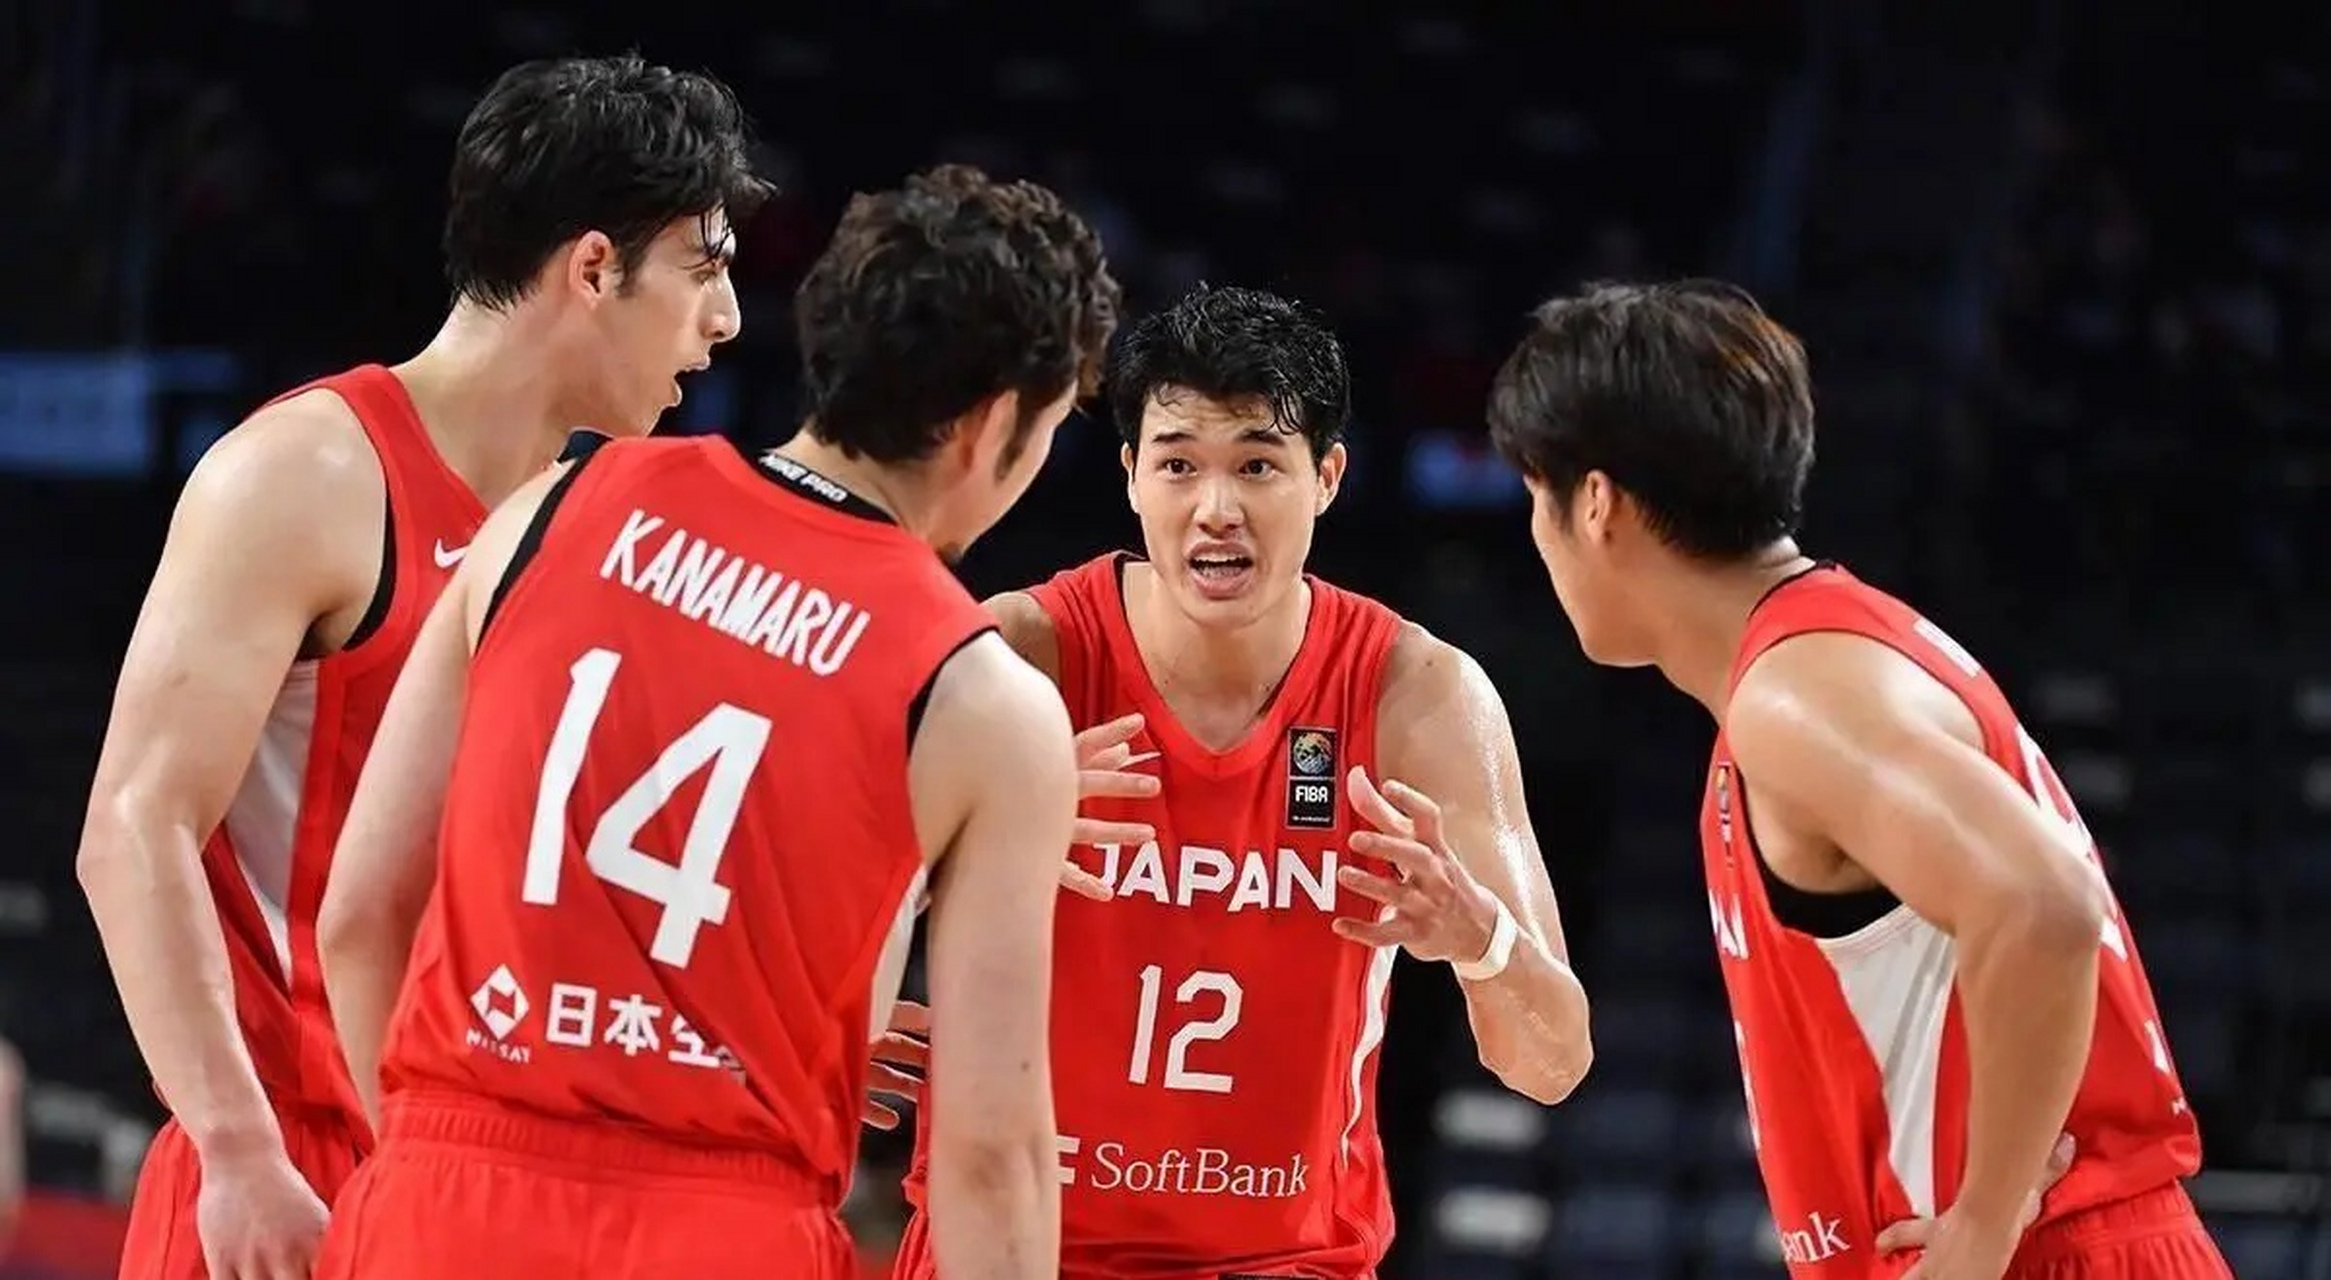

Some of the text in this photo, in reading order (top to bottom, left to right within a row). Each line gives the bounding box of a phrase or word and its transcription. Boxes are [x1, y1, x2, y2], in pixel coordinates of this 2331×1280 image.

[800, 473, 848, 502] PRO
[600, 508, 872, 677] KANAMARU
[522, 647, 773, 970] 14
[1295, 785, 1328, 803] FIBA
[1092, 840, 1338, 912] JAPAN
[546, 982, 747, 1084] 日本生
[1128, 964, 1243, 1093] 12
[1091, 1142, 1310, 1197] SoftBank
